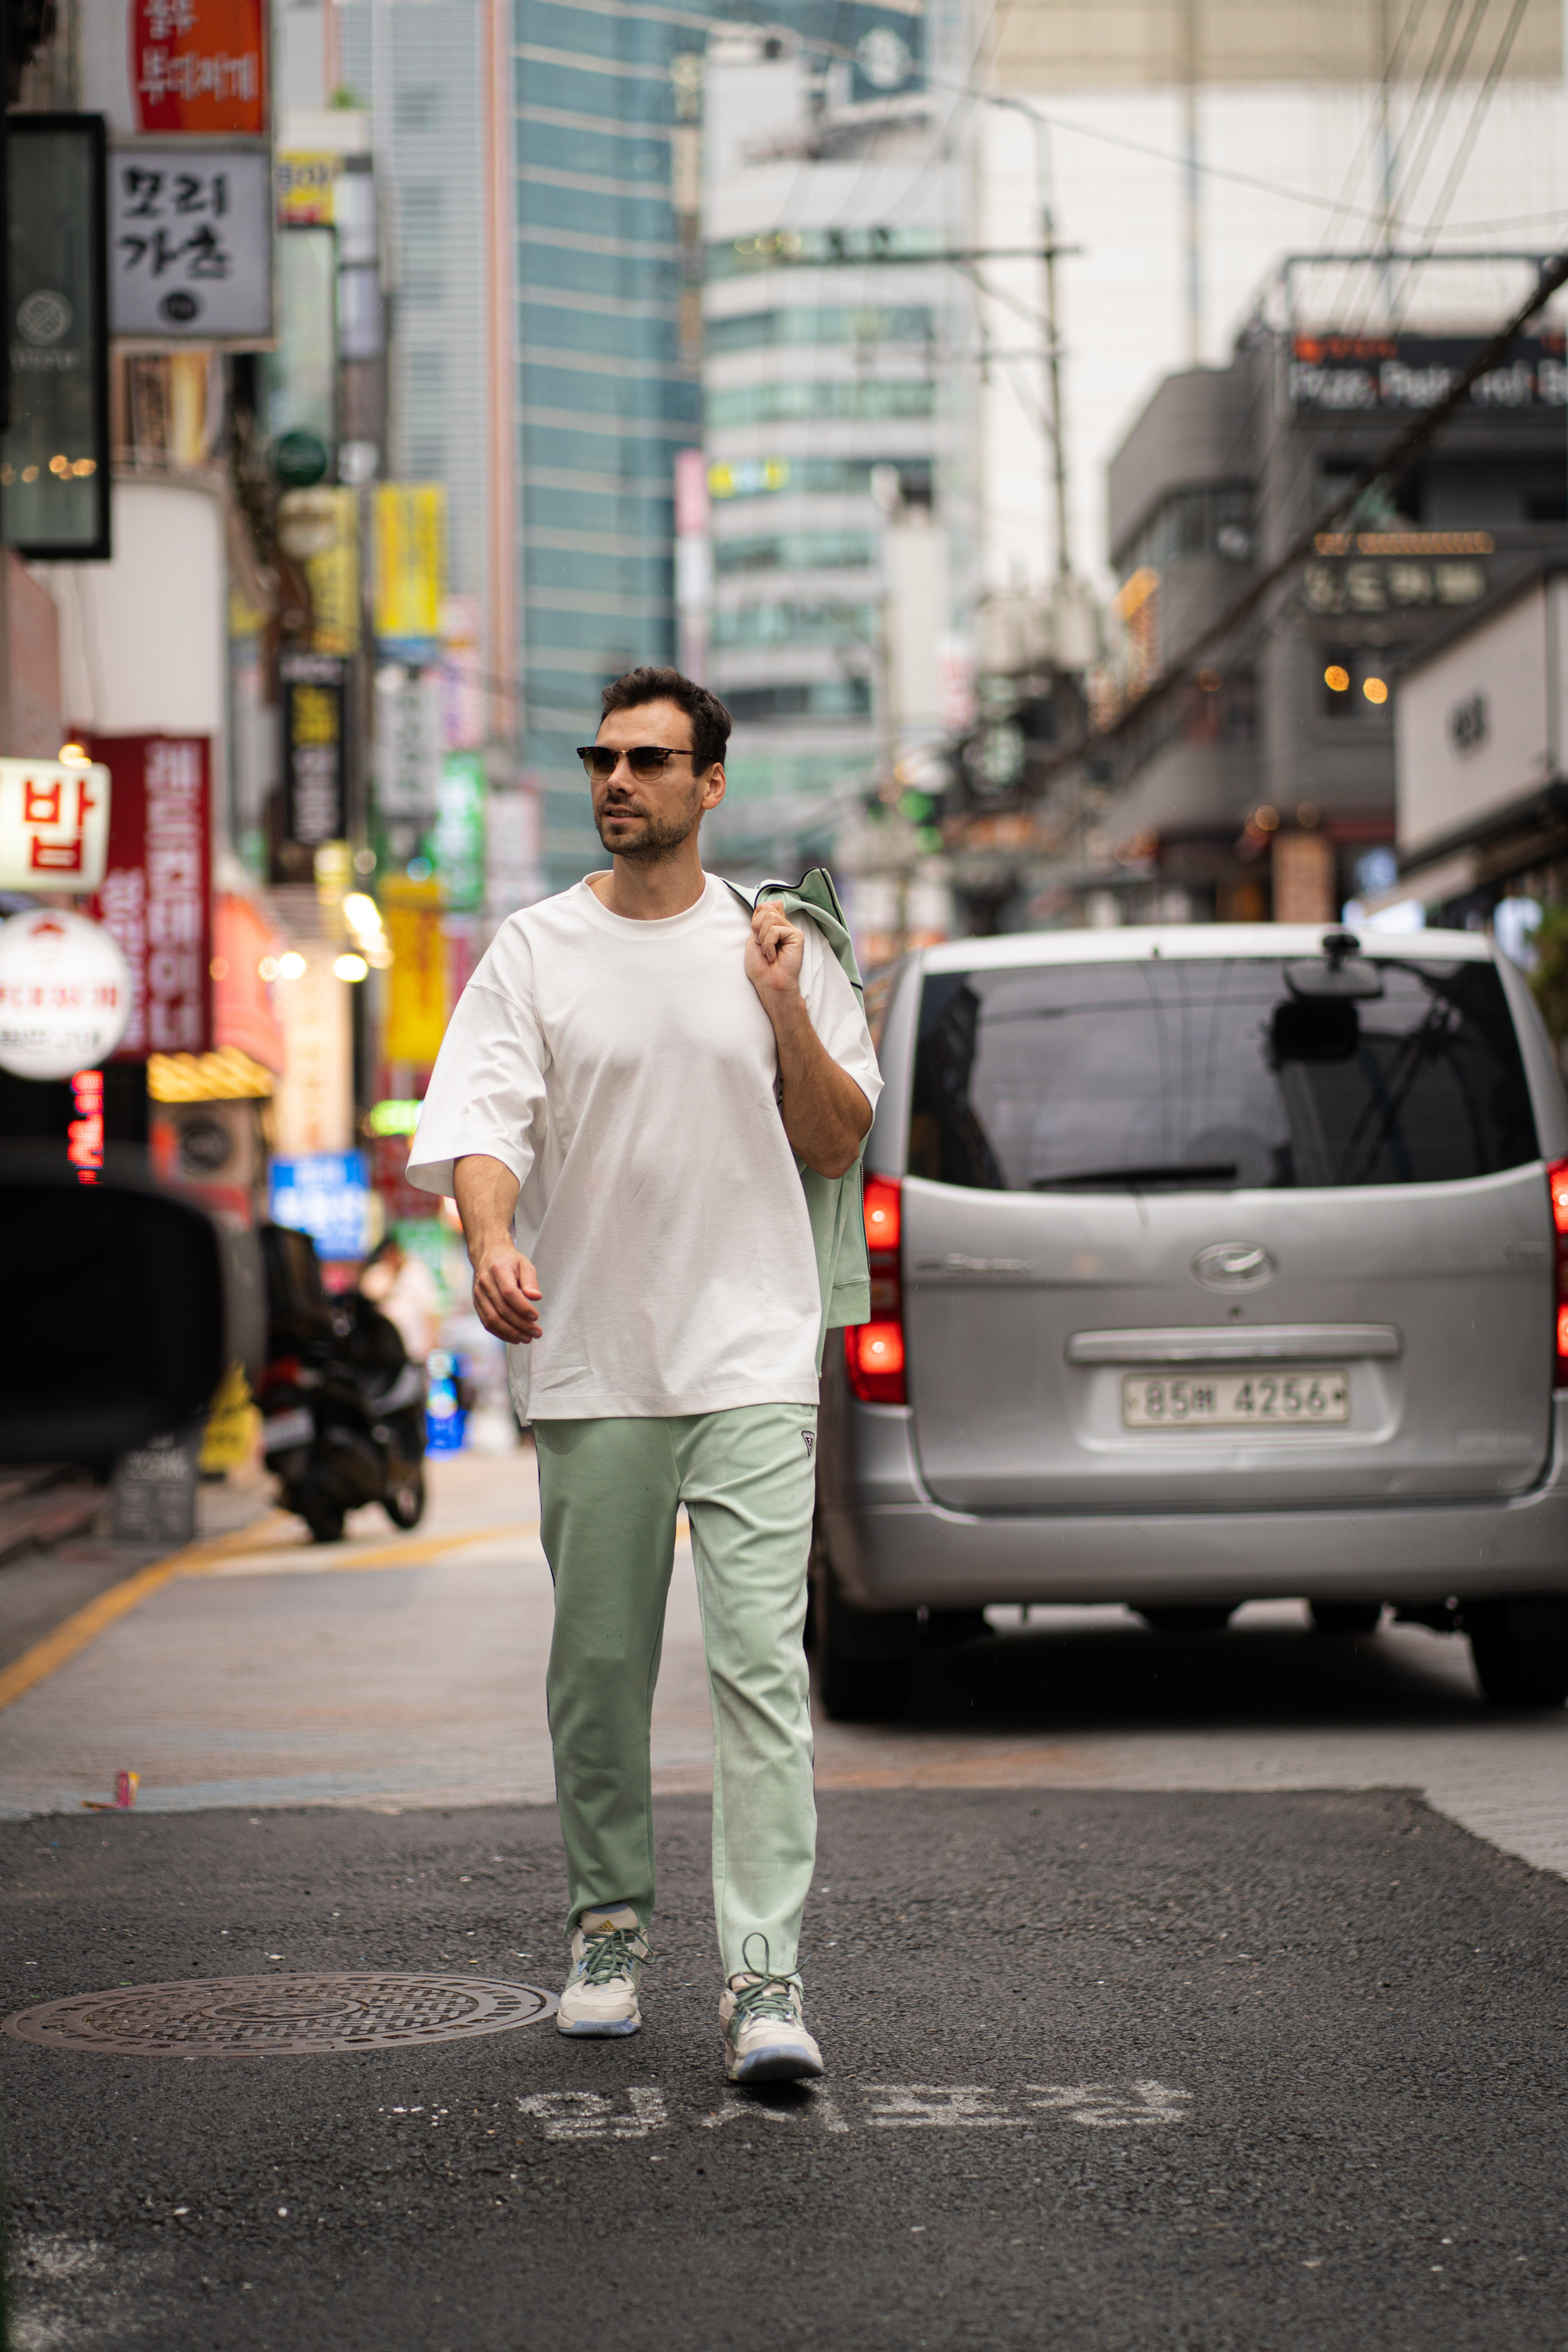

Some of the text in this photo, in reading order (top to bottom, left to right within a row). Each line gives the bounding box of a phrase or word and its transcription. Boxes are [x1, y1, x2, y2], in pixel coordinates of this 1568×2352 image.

[124, 168, 227, 218] 모리
[25, 780, 95, 870] 밥
[1234, 1376, 1327, 1416] 4256
